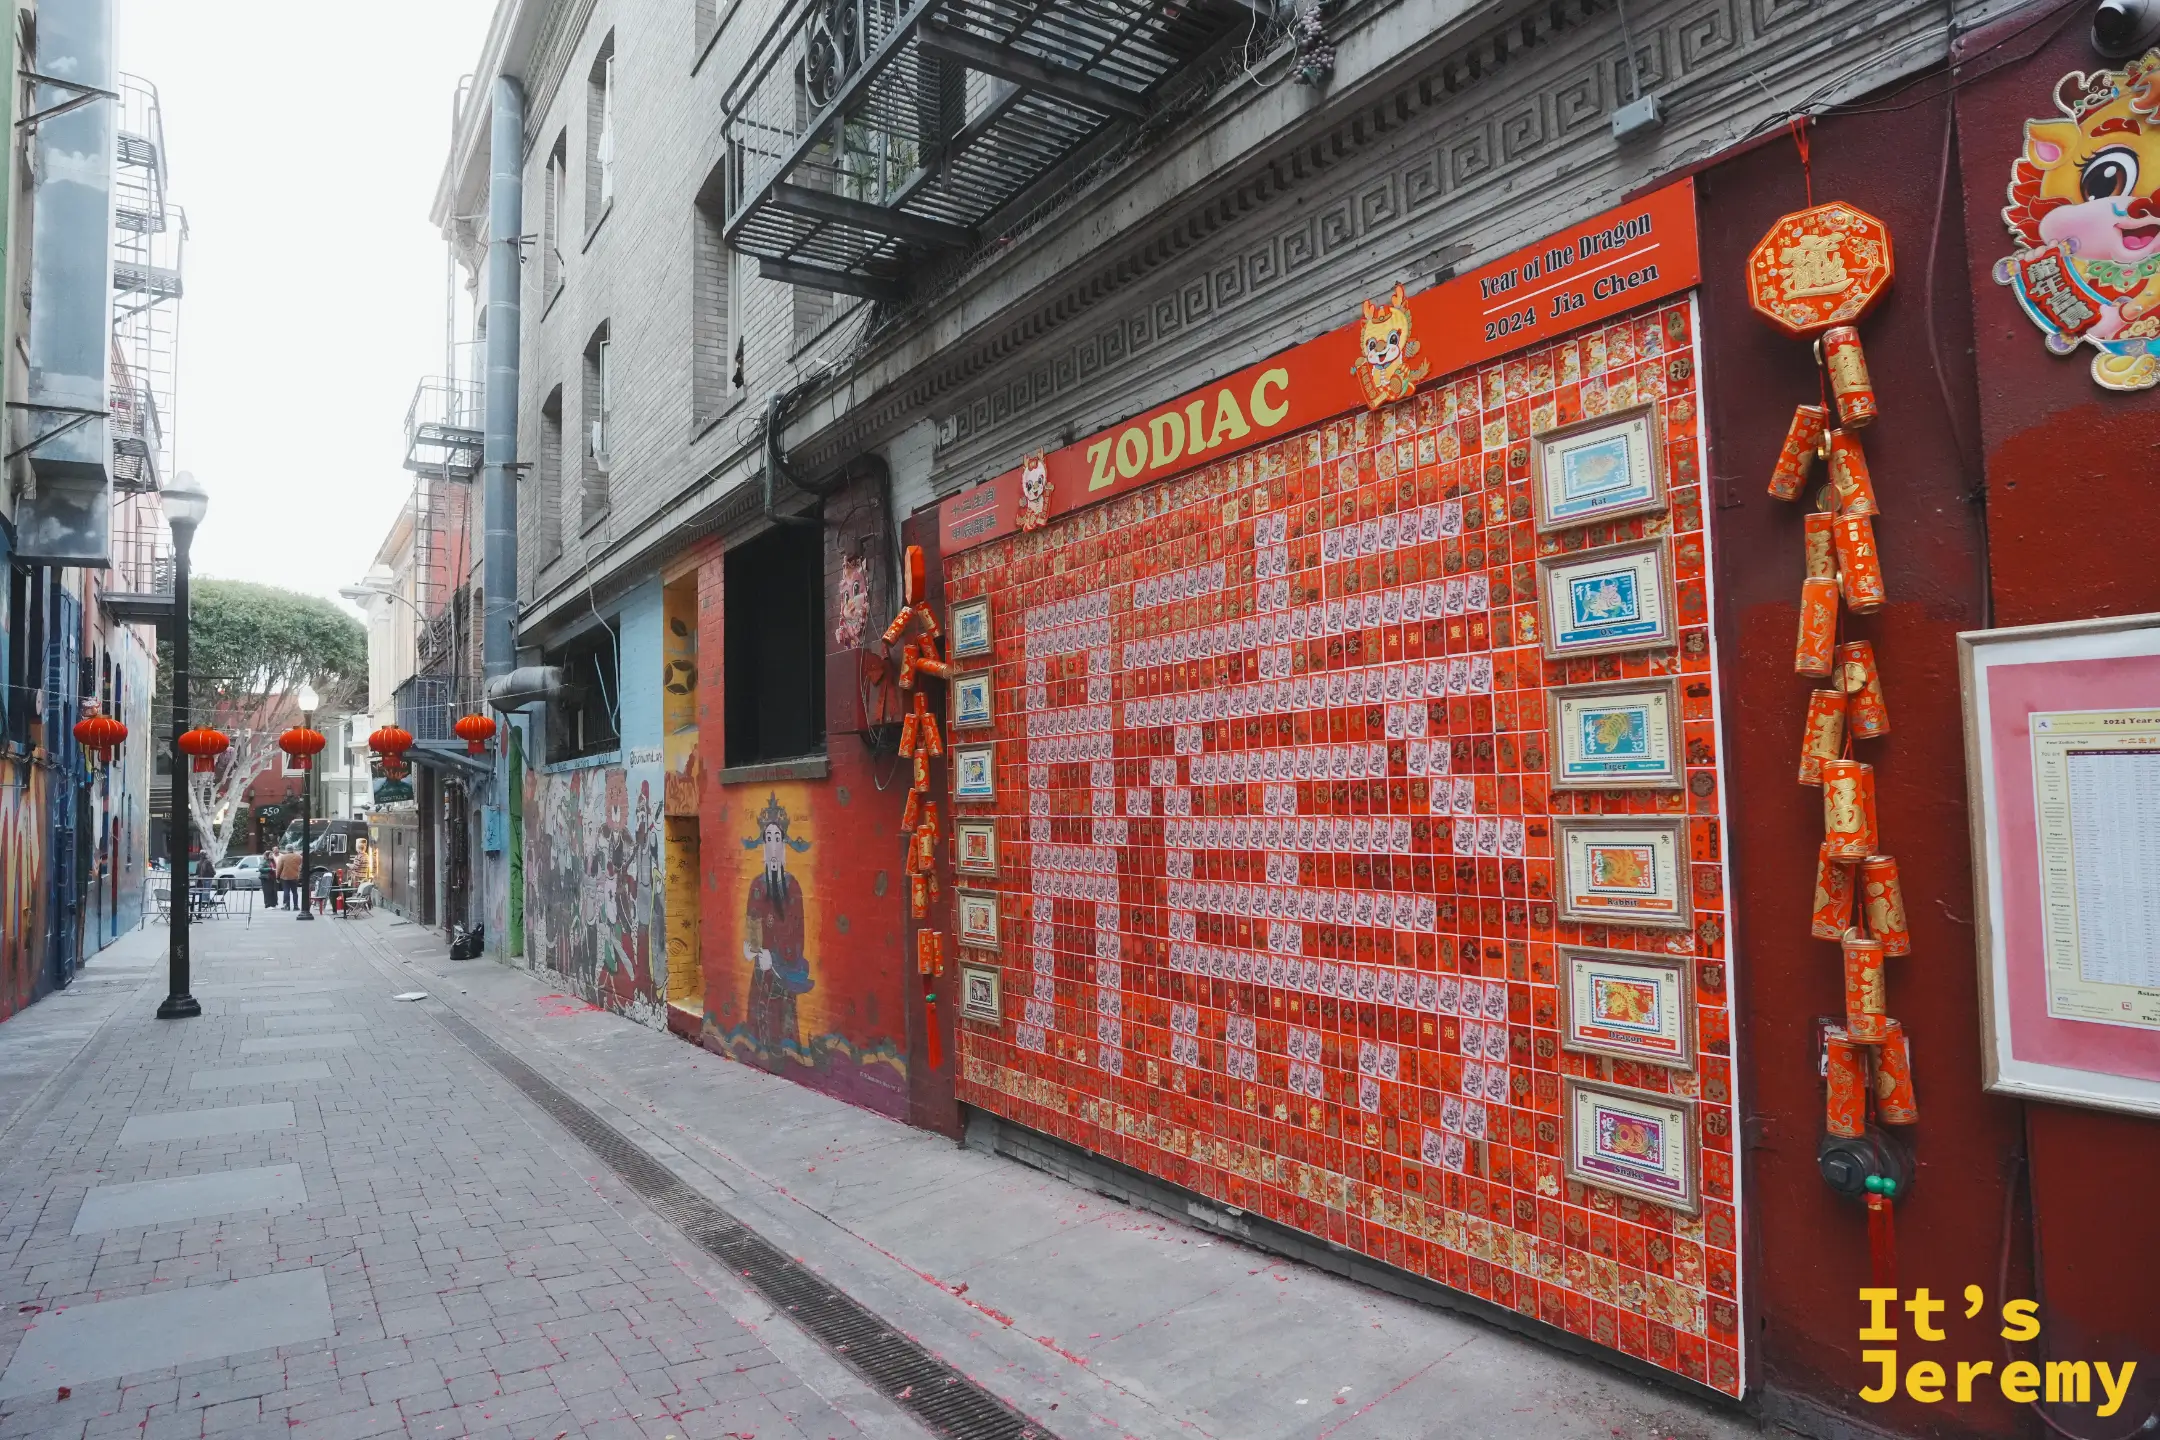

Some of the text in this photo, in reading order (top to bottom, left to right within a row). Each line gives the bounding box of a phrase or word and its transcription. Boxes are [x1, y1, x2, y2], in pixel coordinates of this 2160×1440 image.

[1480, 213, 1652, 300] Year of the Dragon
[1485, 263, 1659, 342] 2024 Jia Chen
[1086, 368, 1290, 492] ZODIAC
[1591, 498, 1607, 507] Rat
[1473, 623, 1484, 637] 招
[1600, 628, 1613, 637] Ox
[1409, 632, 1419, 645] 利
[1603, 762, 1627, 772] Tiger
[262, 807, 280, 816] 250
[1637, 876, 1649, 887] 33
[1607, 898, 1637, 907] Rabbit
[1444, 1027, 1455, 1040] 池
[1608, 1031, 1642, 1043] Dragon
[1646, 1150, 1659, 1162] 34
[1615, 1165, 1643, 1179] Snake
